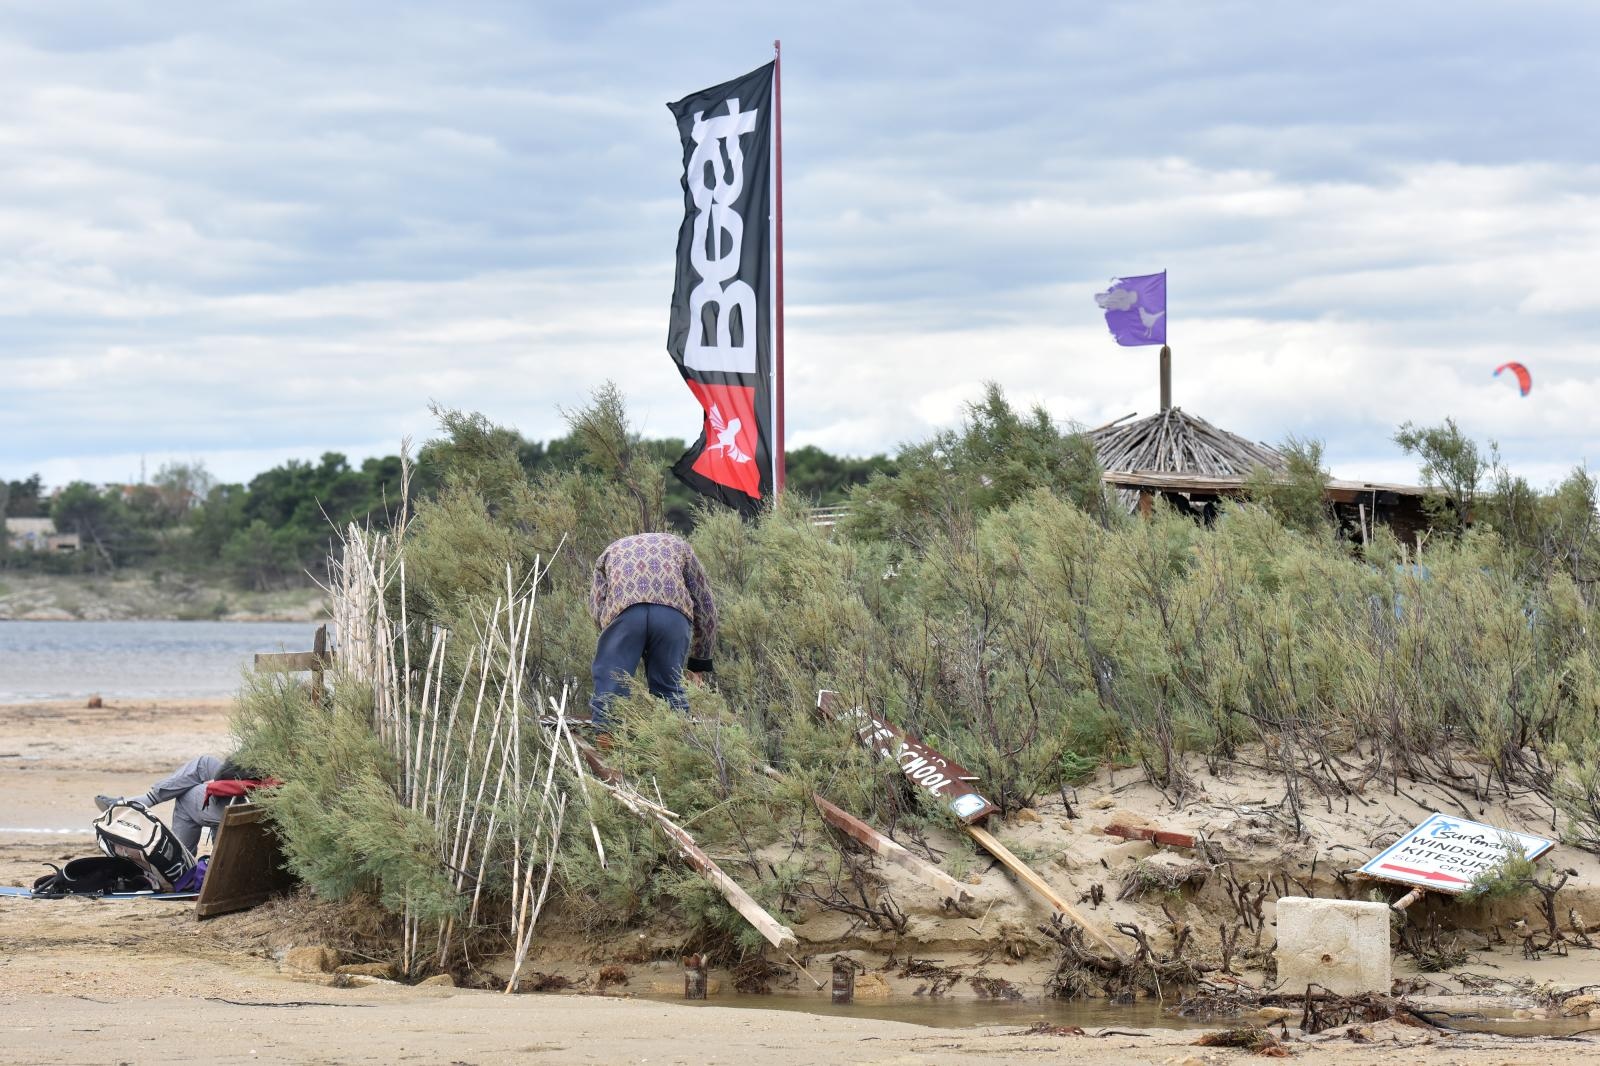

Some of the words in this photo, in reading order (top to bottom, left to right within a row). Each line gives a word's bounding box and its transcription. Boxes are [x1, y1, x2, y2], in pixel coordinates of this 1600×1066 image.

[881, 740, 952, 798] SCHOOL
[1402, 846, 1491, 870] KITESUR
[1411, 836, 1506, 863] WINDSUR
[1439, 864, 1483, 877] CENT
